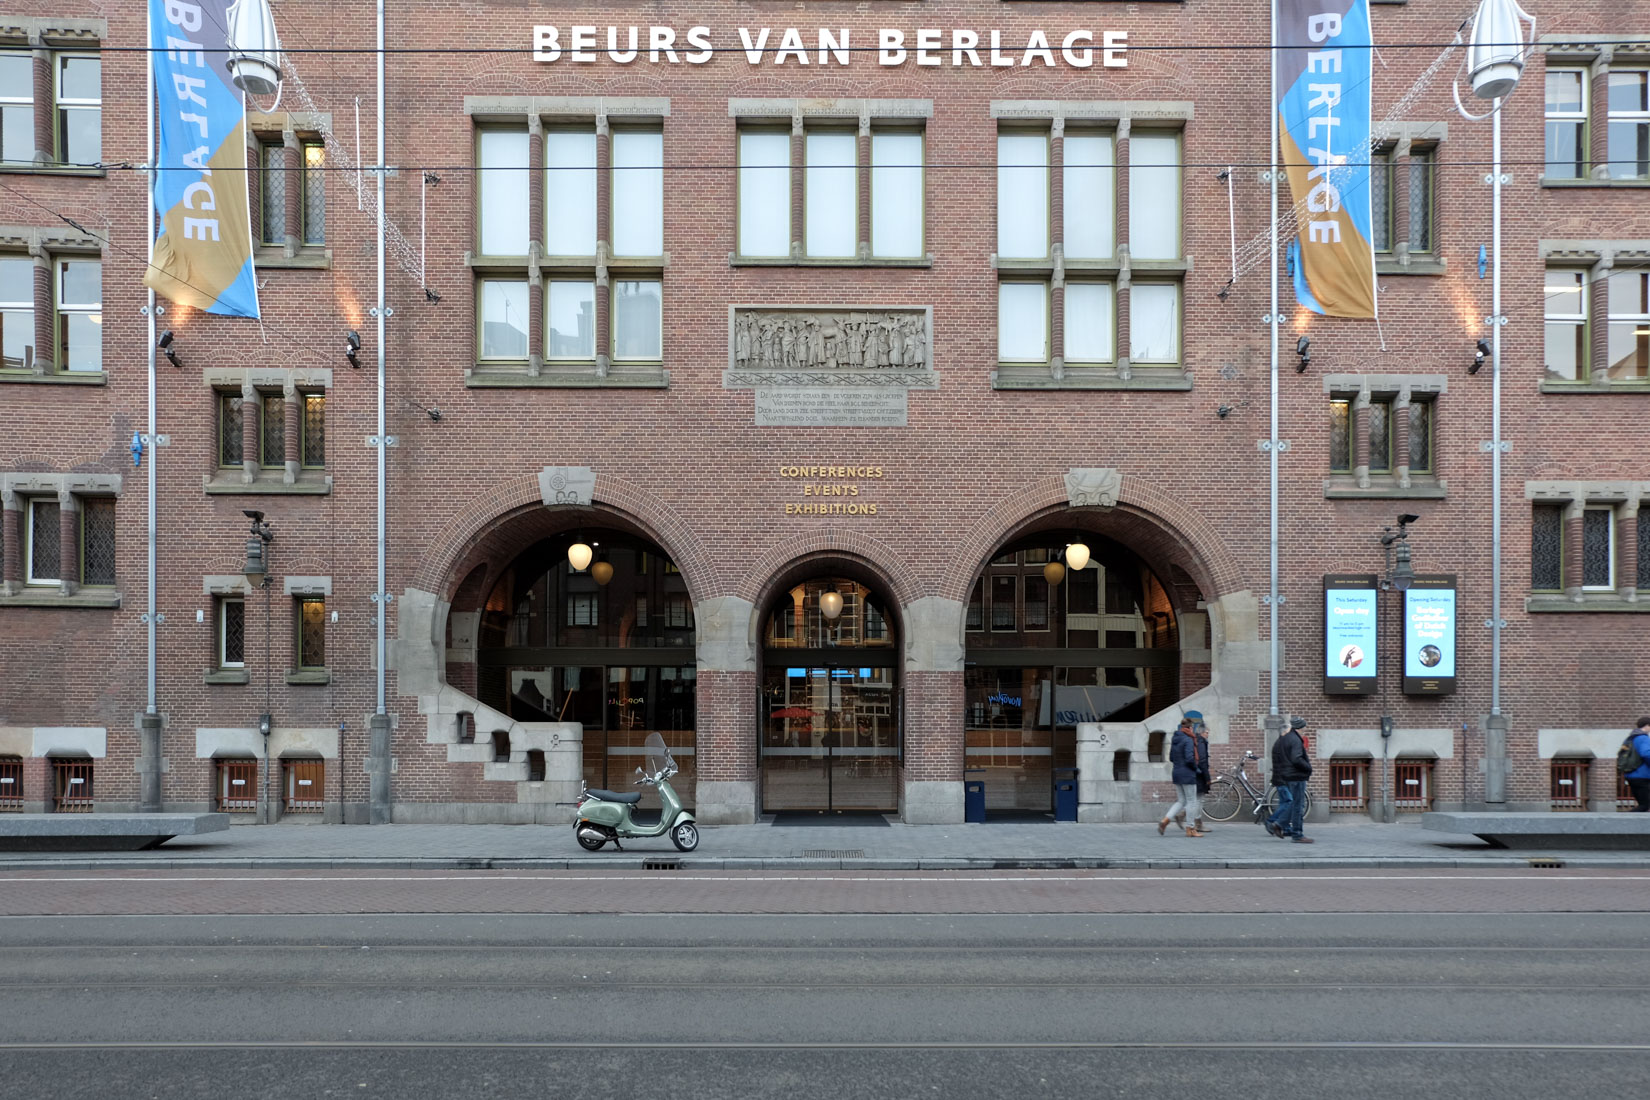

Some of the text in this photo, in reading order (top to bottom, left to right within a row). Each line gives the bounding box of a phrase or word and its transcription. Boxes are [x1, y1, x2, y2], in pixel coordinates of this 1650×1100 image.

[532, 24, 1129, 68] BEURS VAN BERLAGE
[1308, 12, 1342, 244] BERLAGE
[780, 466, 883, 478] CONFERENCES
[804, 485, 859, 496] EVENTS
[785, 503, 877, 515] EXHIBITIONS
